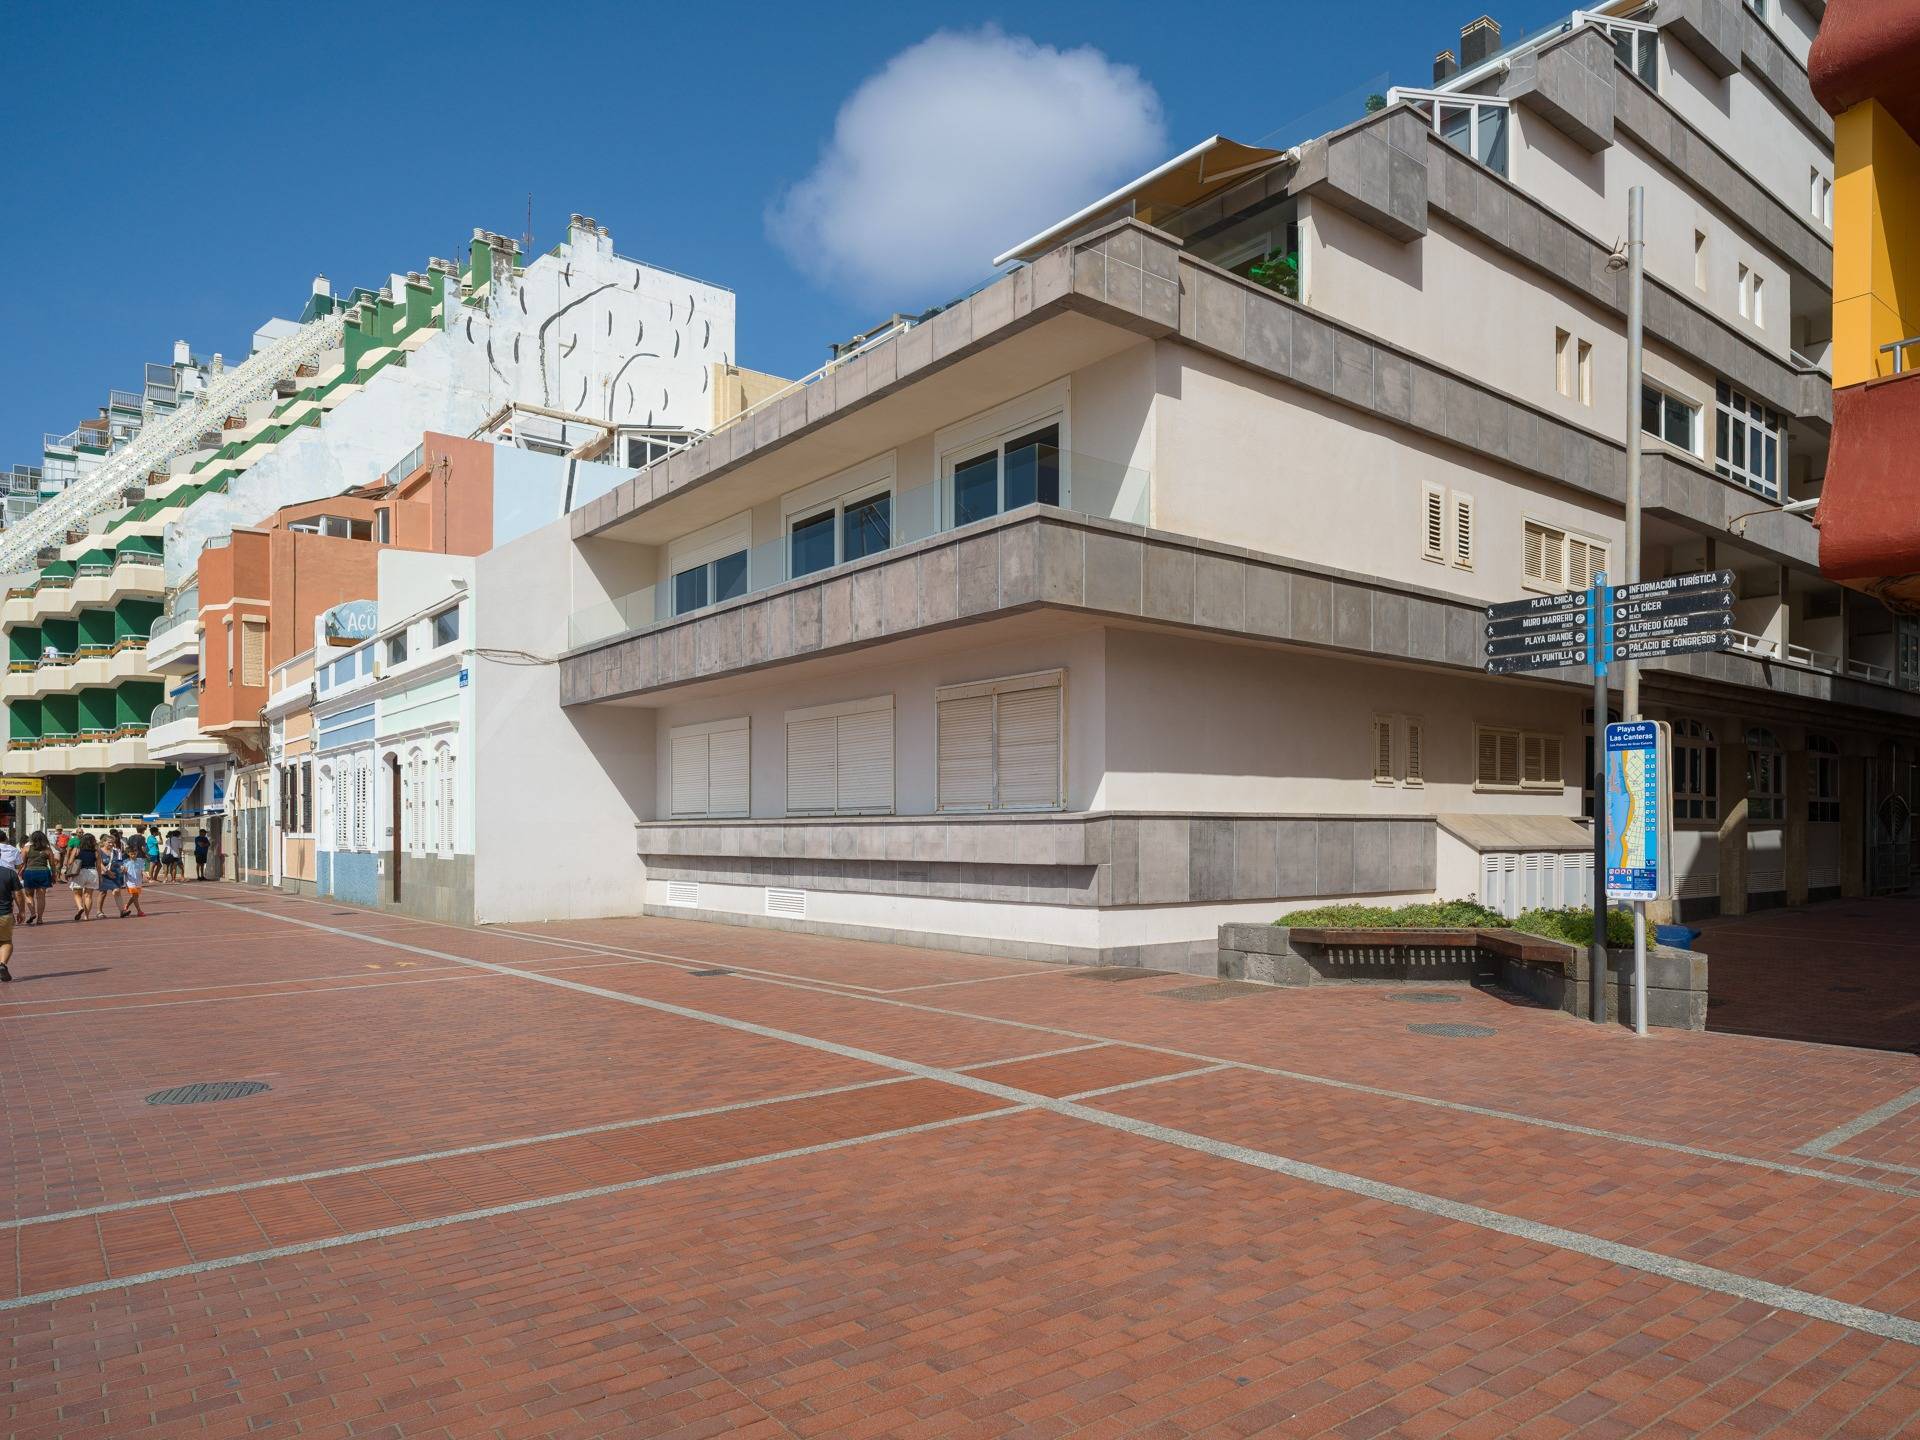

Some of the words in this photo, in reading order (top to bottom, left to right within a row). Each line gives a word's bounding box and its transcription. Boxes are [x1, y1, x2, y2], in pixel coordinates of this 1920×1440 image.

[1629, 577, 1677, 594] INFORMACIÓN
[1679, 573, 1717, 587] TURÍSTICA
[1531, 598, 1553, 609] PLAYA
[1553, 594, 1574, 606] CHICA
[1628, 604, 1639, 614] LA
[1641, 600, 1662, 612] CÍCER
[1522, 617, 1541, 628] MURO
[1541, 613, 1574, 625] MARRERO
[1628, 621, 1662, 633] ALFREDO
[1663, 617, 1688, 628] KRAUS
[1524, 635, 1546, 646] PLAYA
[1547, 631, 1574, 643] GRANDE
[1628, 640, 1659, 652] PALACIO
[1661, 639, 1671, 649] DE
[1673, 634, 1717, 647] CONGRESOS
[1531, 654, 1541, 663] LA
[1542, 650, 1574, 662] PUNTILLA
[1628, 651, 1652, 659] CONFERENCE
[1616, 725, 1636, 733] Playa
[1623, 733, 1653, 741] Canteras
